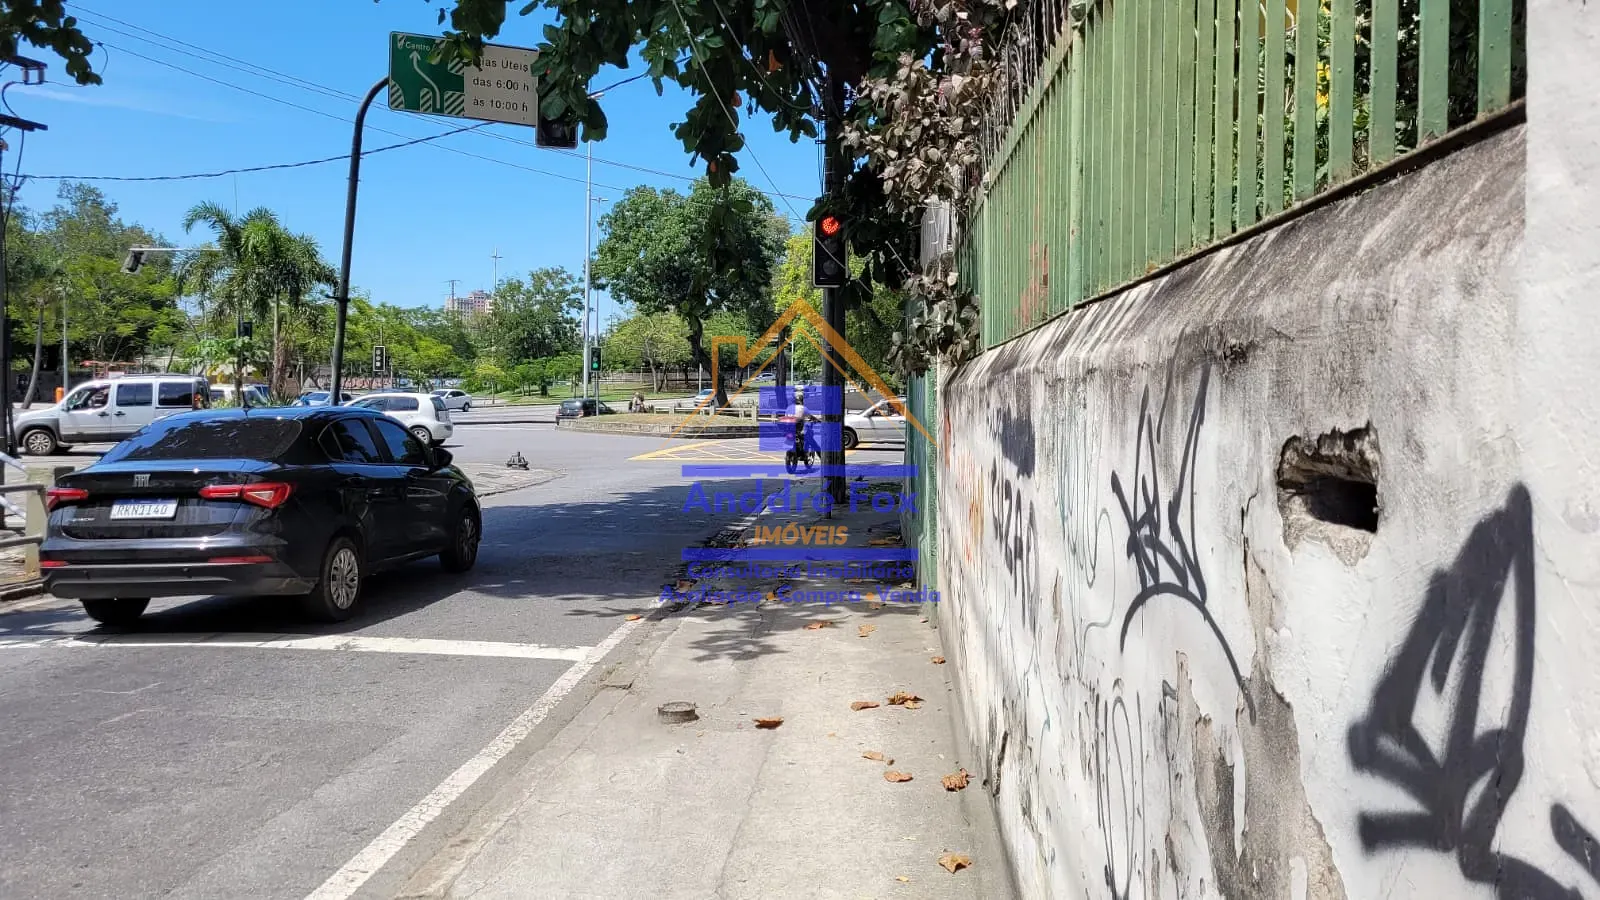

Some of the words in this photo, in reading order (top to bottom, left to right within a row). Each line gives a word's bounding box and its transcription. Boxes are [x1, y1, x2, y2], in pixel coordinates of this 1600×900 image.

[479, 58, 497, 68] ias
[472, 77, 492, 88] das
[496, 79, 519, 91] 6:00
[523, 82, 529, 92] h
[490, 99, 518, 111] 10:00
[522, 101, 528, 112] h
